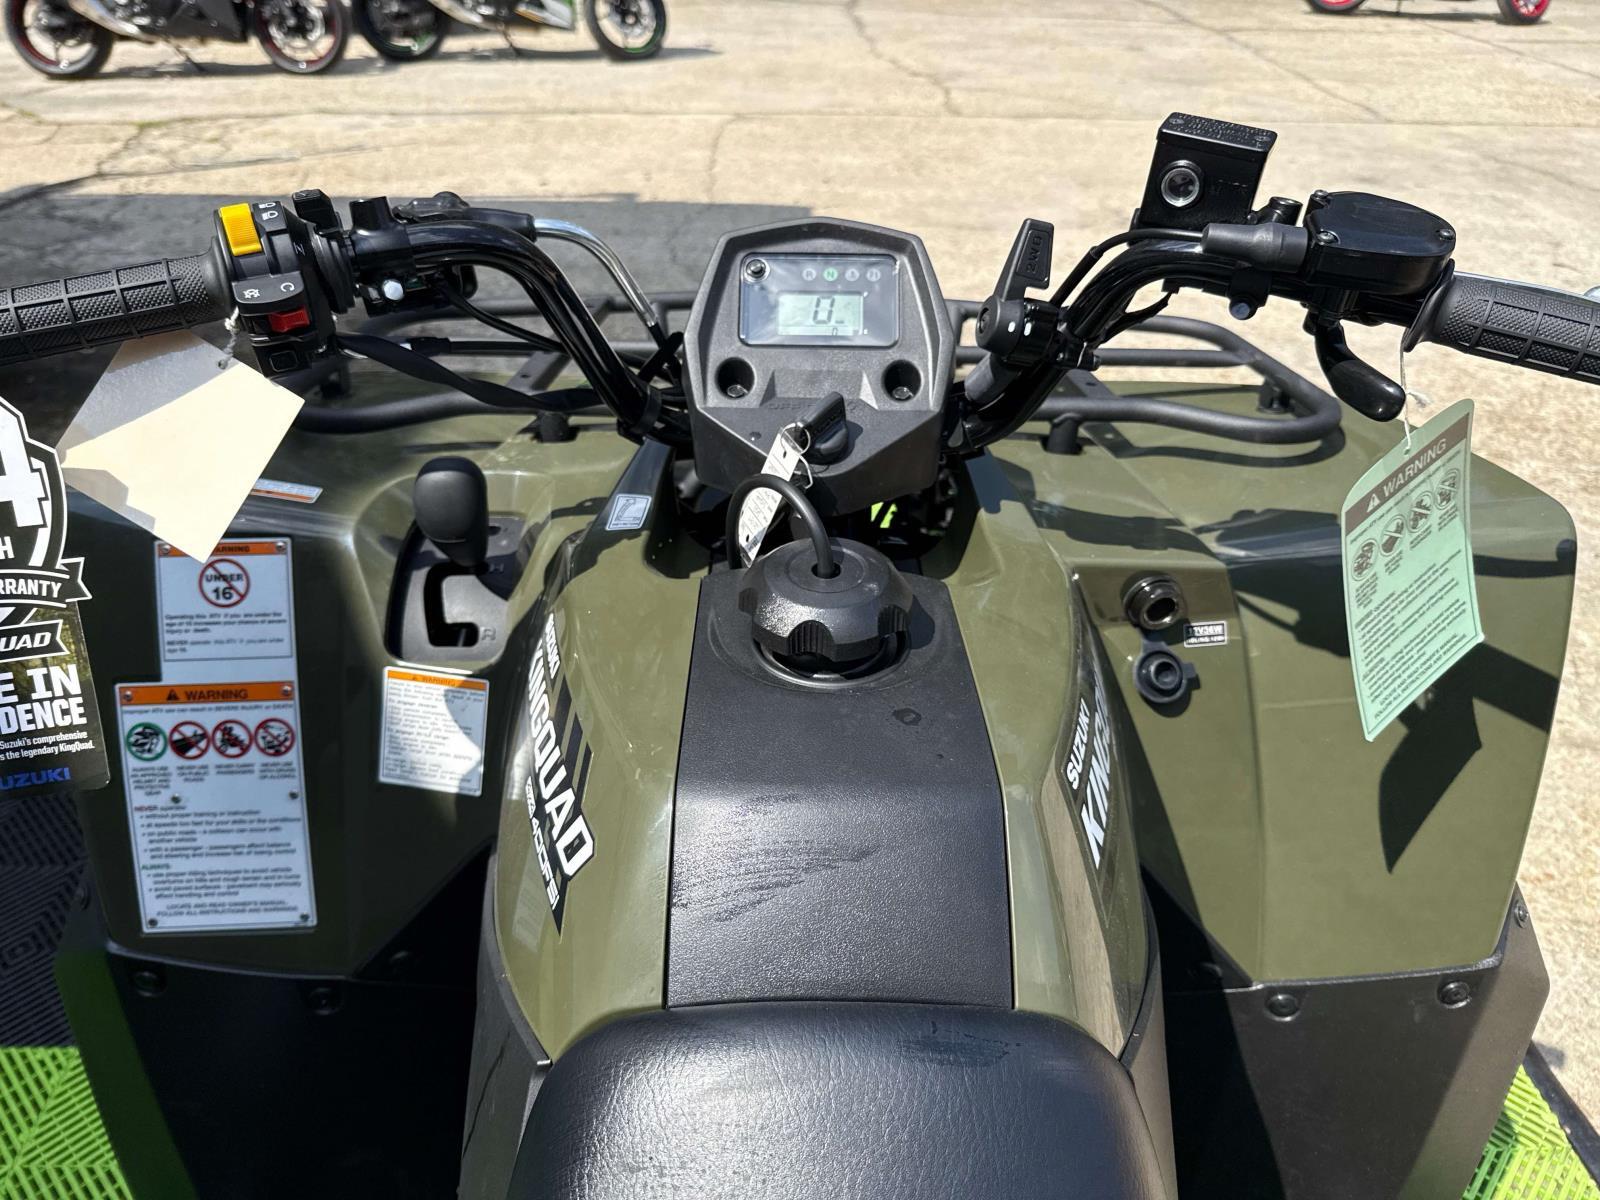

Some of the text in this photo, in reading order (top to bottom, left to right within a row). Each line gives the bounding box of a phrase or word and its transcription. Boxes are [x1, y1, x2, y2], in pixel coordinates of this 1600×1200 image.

[813, 296, 836, 325] 0
[1382, 438, 1447, 497] WARNING
[215, 545, 251, 554] ARNING
[204, 573, 244, 583] UNDER
[211, 586, 234, 601] 16
[481, 628, 497, 641] R
[27, 664, 81, 700] IN
[184, 689, 248, 702] WARNING
[0, 731, 88, 753] Suzuki's comprehensive
[1066, 697, 1090, 790] SUZUKI
[6, 750, 20, 761] the
[21, 744, 58, 760] legendary
